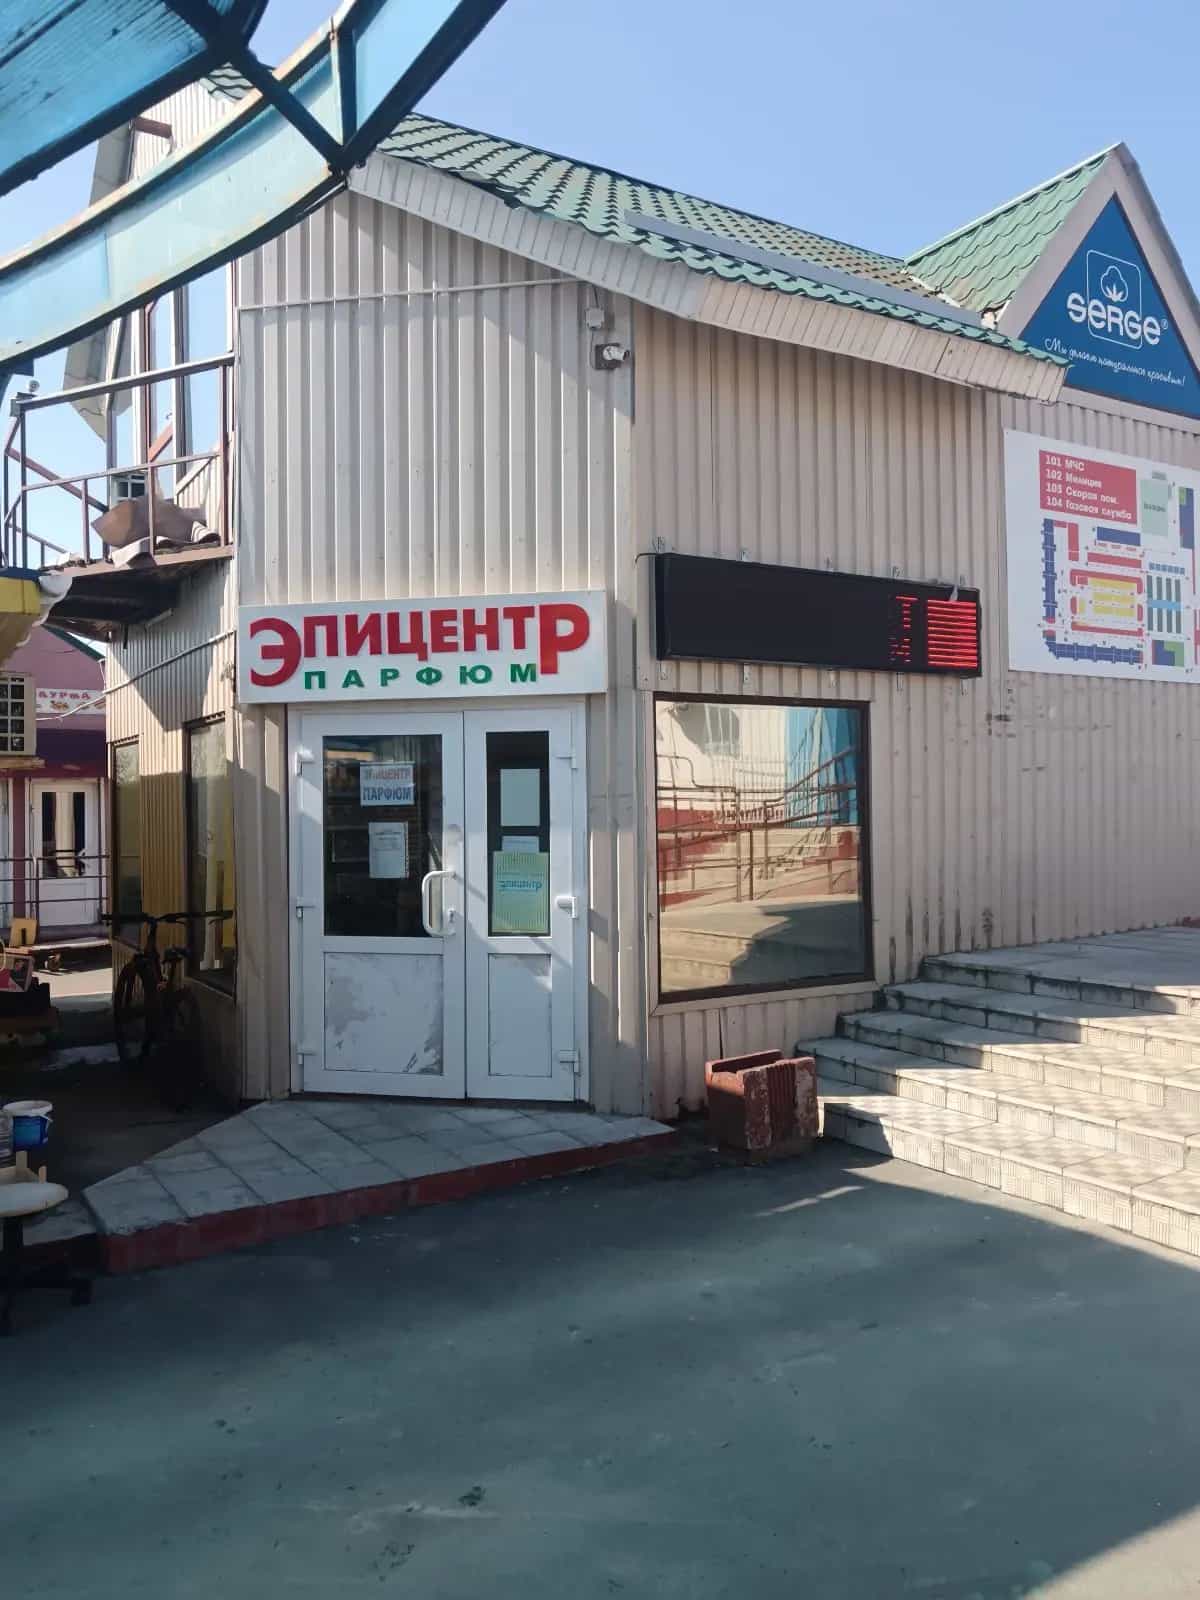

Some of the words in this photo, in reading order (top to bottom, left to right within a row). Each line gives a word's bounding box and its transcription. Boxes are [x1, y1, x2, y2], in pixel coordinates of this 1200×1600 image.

[1045, 455, 1061, 467] 101
[1064, 459, 1085, 471] МЧС
[1046, 469, 1062, 481] 102
[1046, 482, 1062, 494] 103
[1046, 496, 1063, 507] 104
[250, 603, 590, 687] ЭПИЦЕНТР
[304, 663, 537, 690] ПАРФЮМ
[39, 691, 91, 700] АУРМА
[363, 786, 412, 801] ПАРФЮМ
